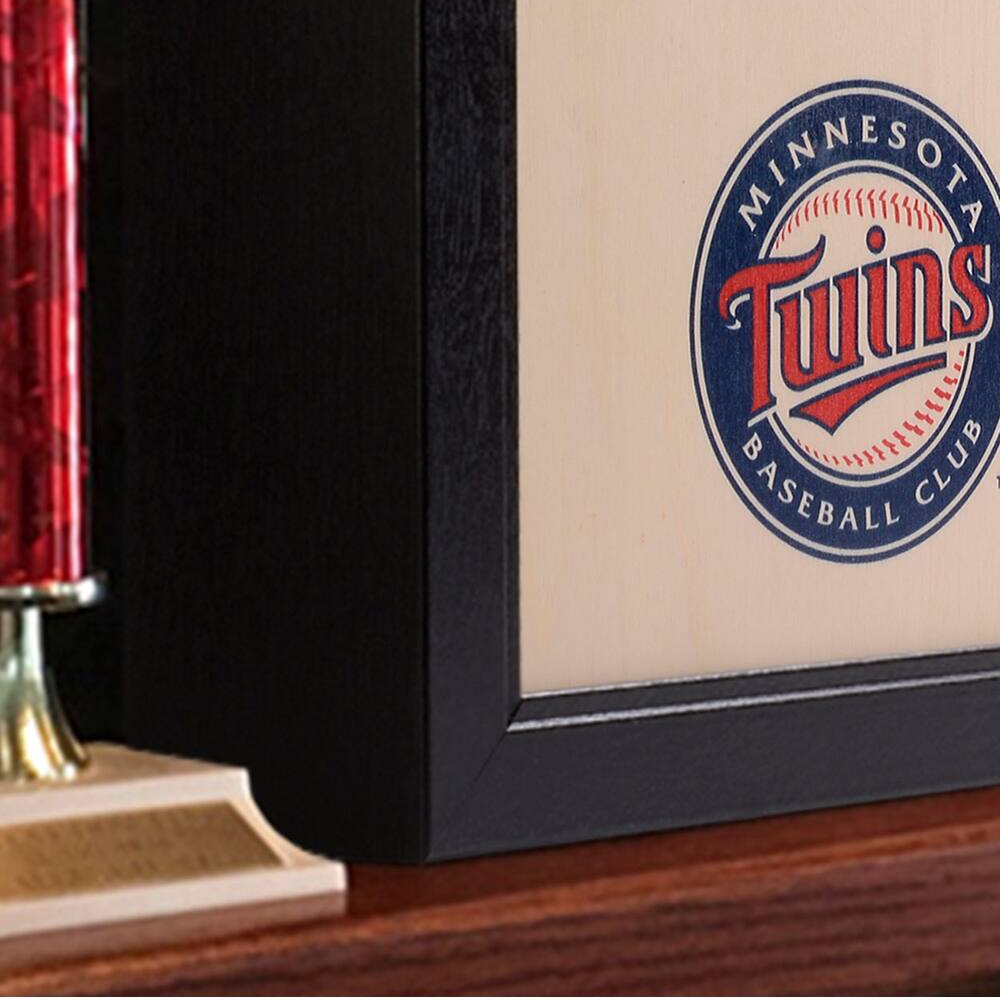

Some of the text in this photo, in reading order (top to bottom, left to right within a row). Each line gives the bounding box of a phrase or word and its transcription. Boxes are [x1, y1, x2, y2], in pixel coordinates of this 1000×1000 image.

[738, 115, 984, 232] MINNESOTA
[718, 225, 992, 414] Twins
[742, 418, 982, 531] BASEBALL CLUB
